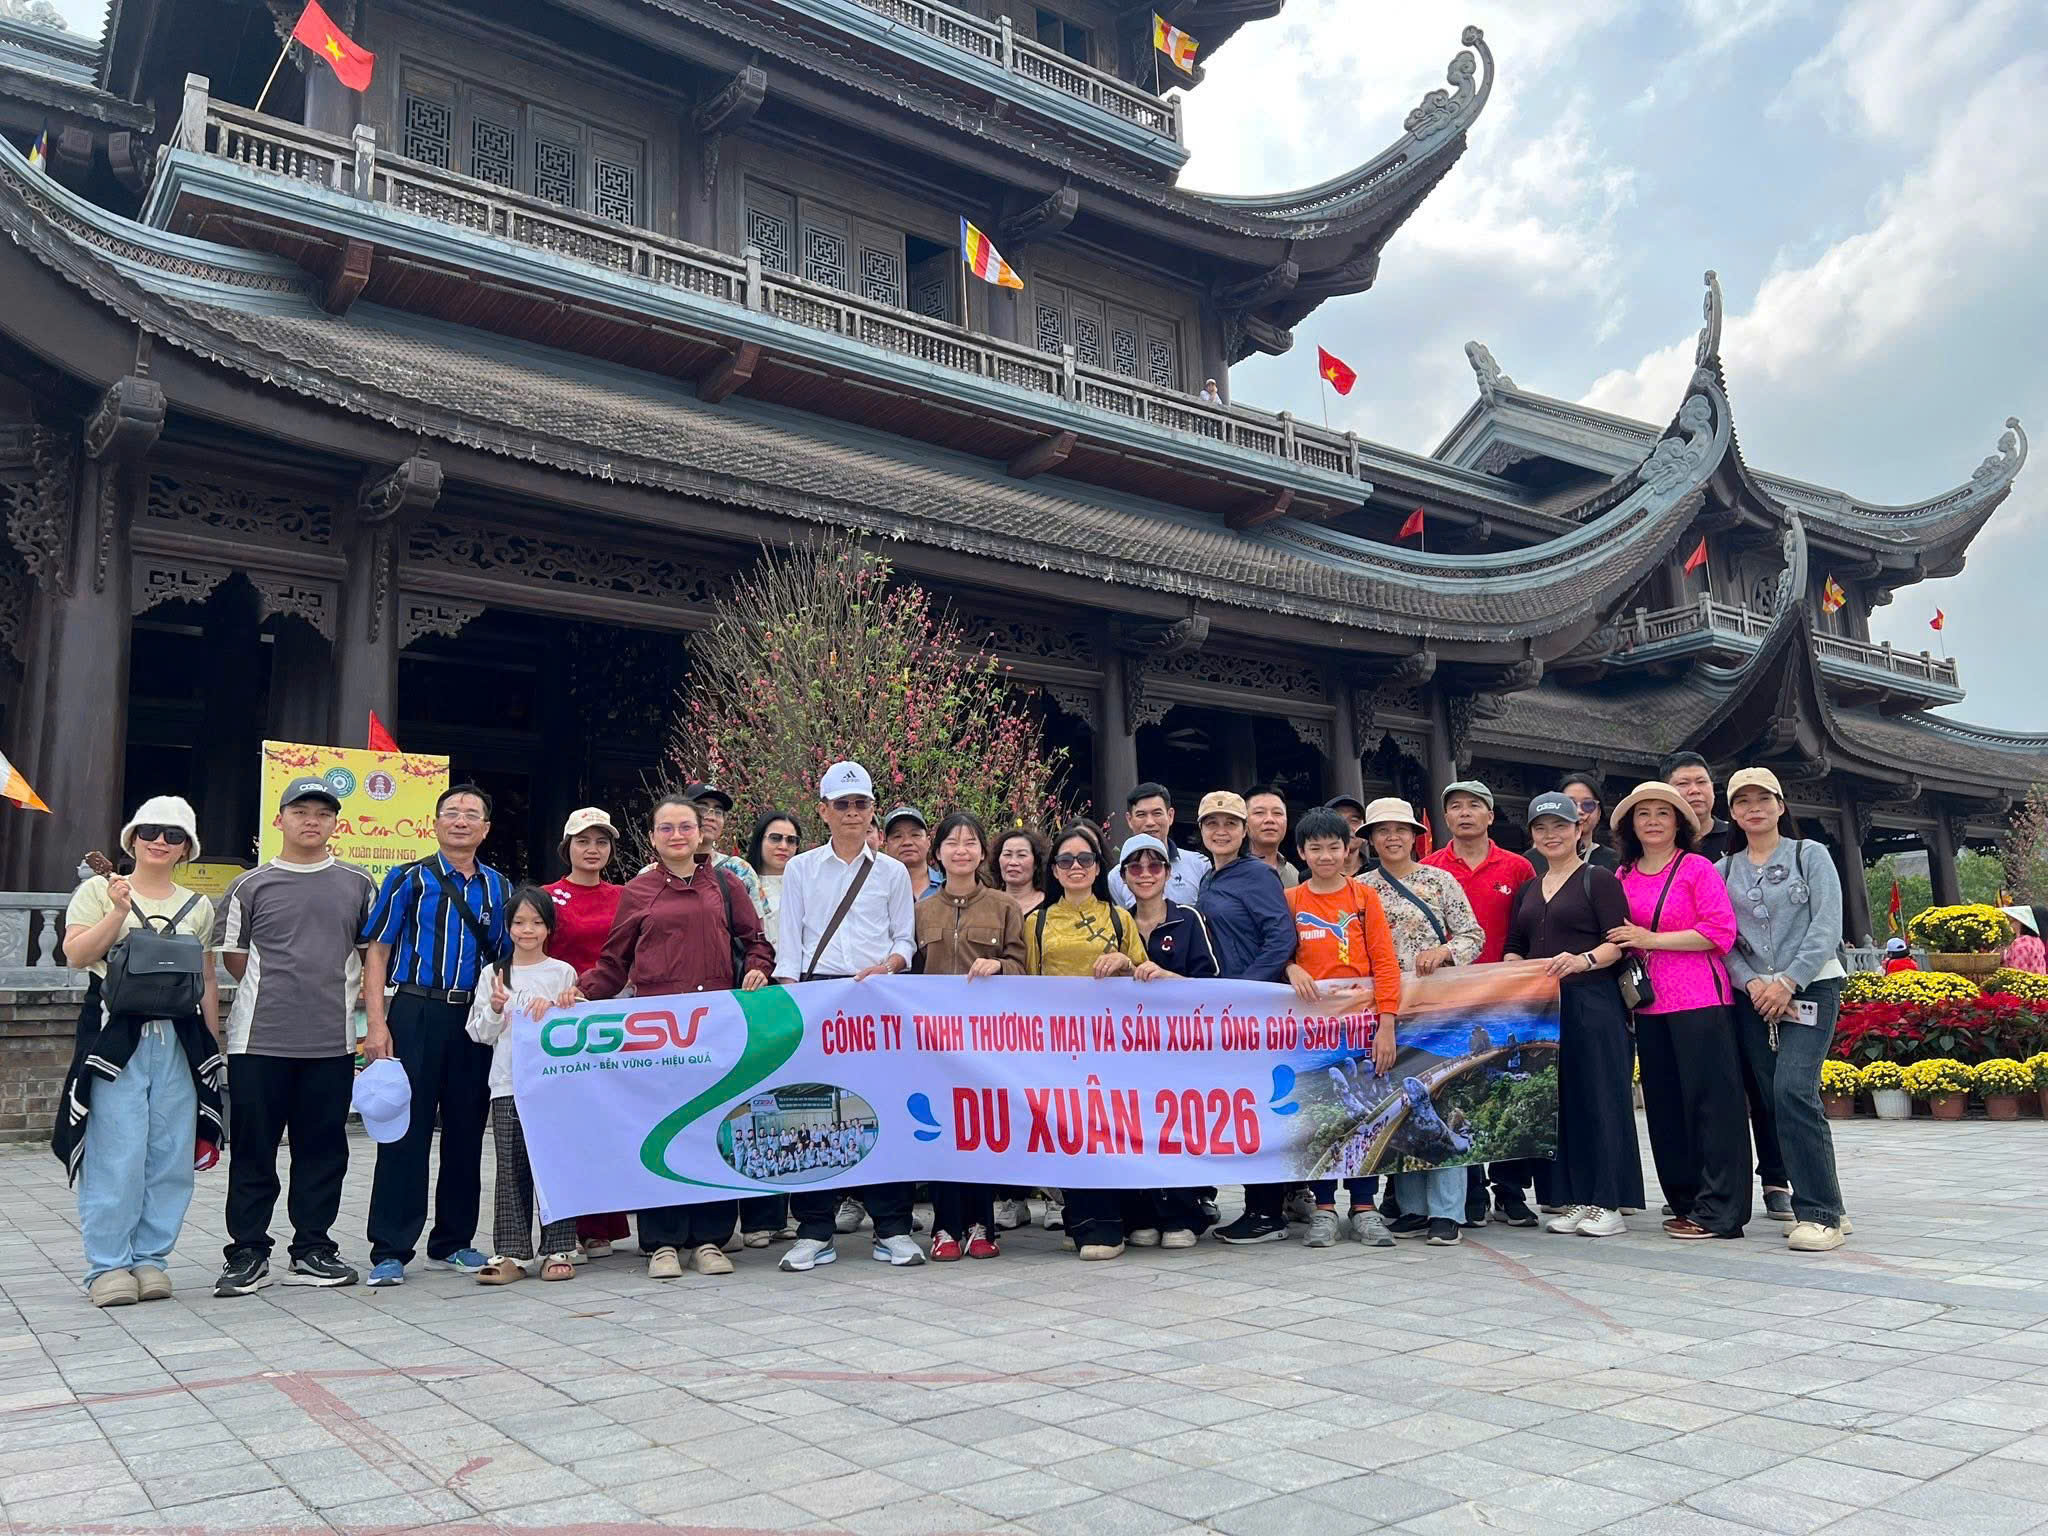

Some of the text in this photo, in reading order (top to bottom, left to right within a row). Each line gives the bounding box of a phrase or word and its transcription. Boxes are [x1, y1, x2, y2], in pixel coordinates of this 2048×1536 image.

[1300, 929, 1326, 940] PUMA
[821, 1009, 876, 1056] CÔNG
[880, 1014, 902, 1051] TY
[913, 1015, 964, 1051] TNHH
[969, 1011, 1044, 1053] THƯƠNG
[1050, 1015, 1087, 1061] MẠI
[1092, 1007, 1117, 1053] VÀ
[1121, 1003, 1160, 1052] SẢN
[1166, 1003, 1214, 1052] XUẤT
[1220, 1003, 1260, 1051] ỐNG
[1266, 1008, 1298, 1051] GIÓ
[1303, 1015, 1340, 1050] SAO
[542, 1066, 558, 1076] AN
[560, 1059, 591, 1074] TOÀN
[600, 1056, 619, 1070] BỀN
[623, 1057, 653, 1069] VỮNG
[662, 1054, 685, 1067] HIỆU
[688, 1051, 712, 1065] QUẢ
[952, 1074, 1261, 1156] DU XUÂN 2026
